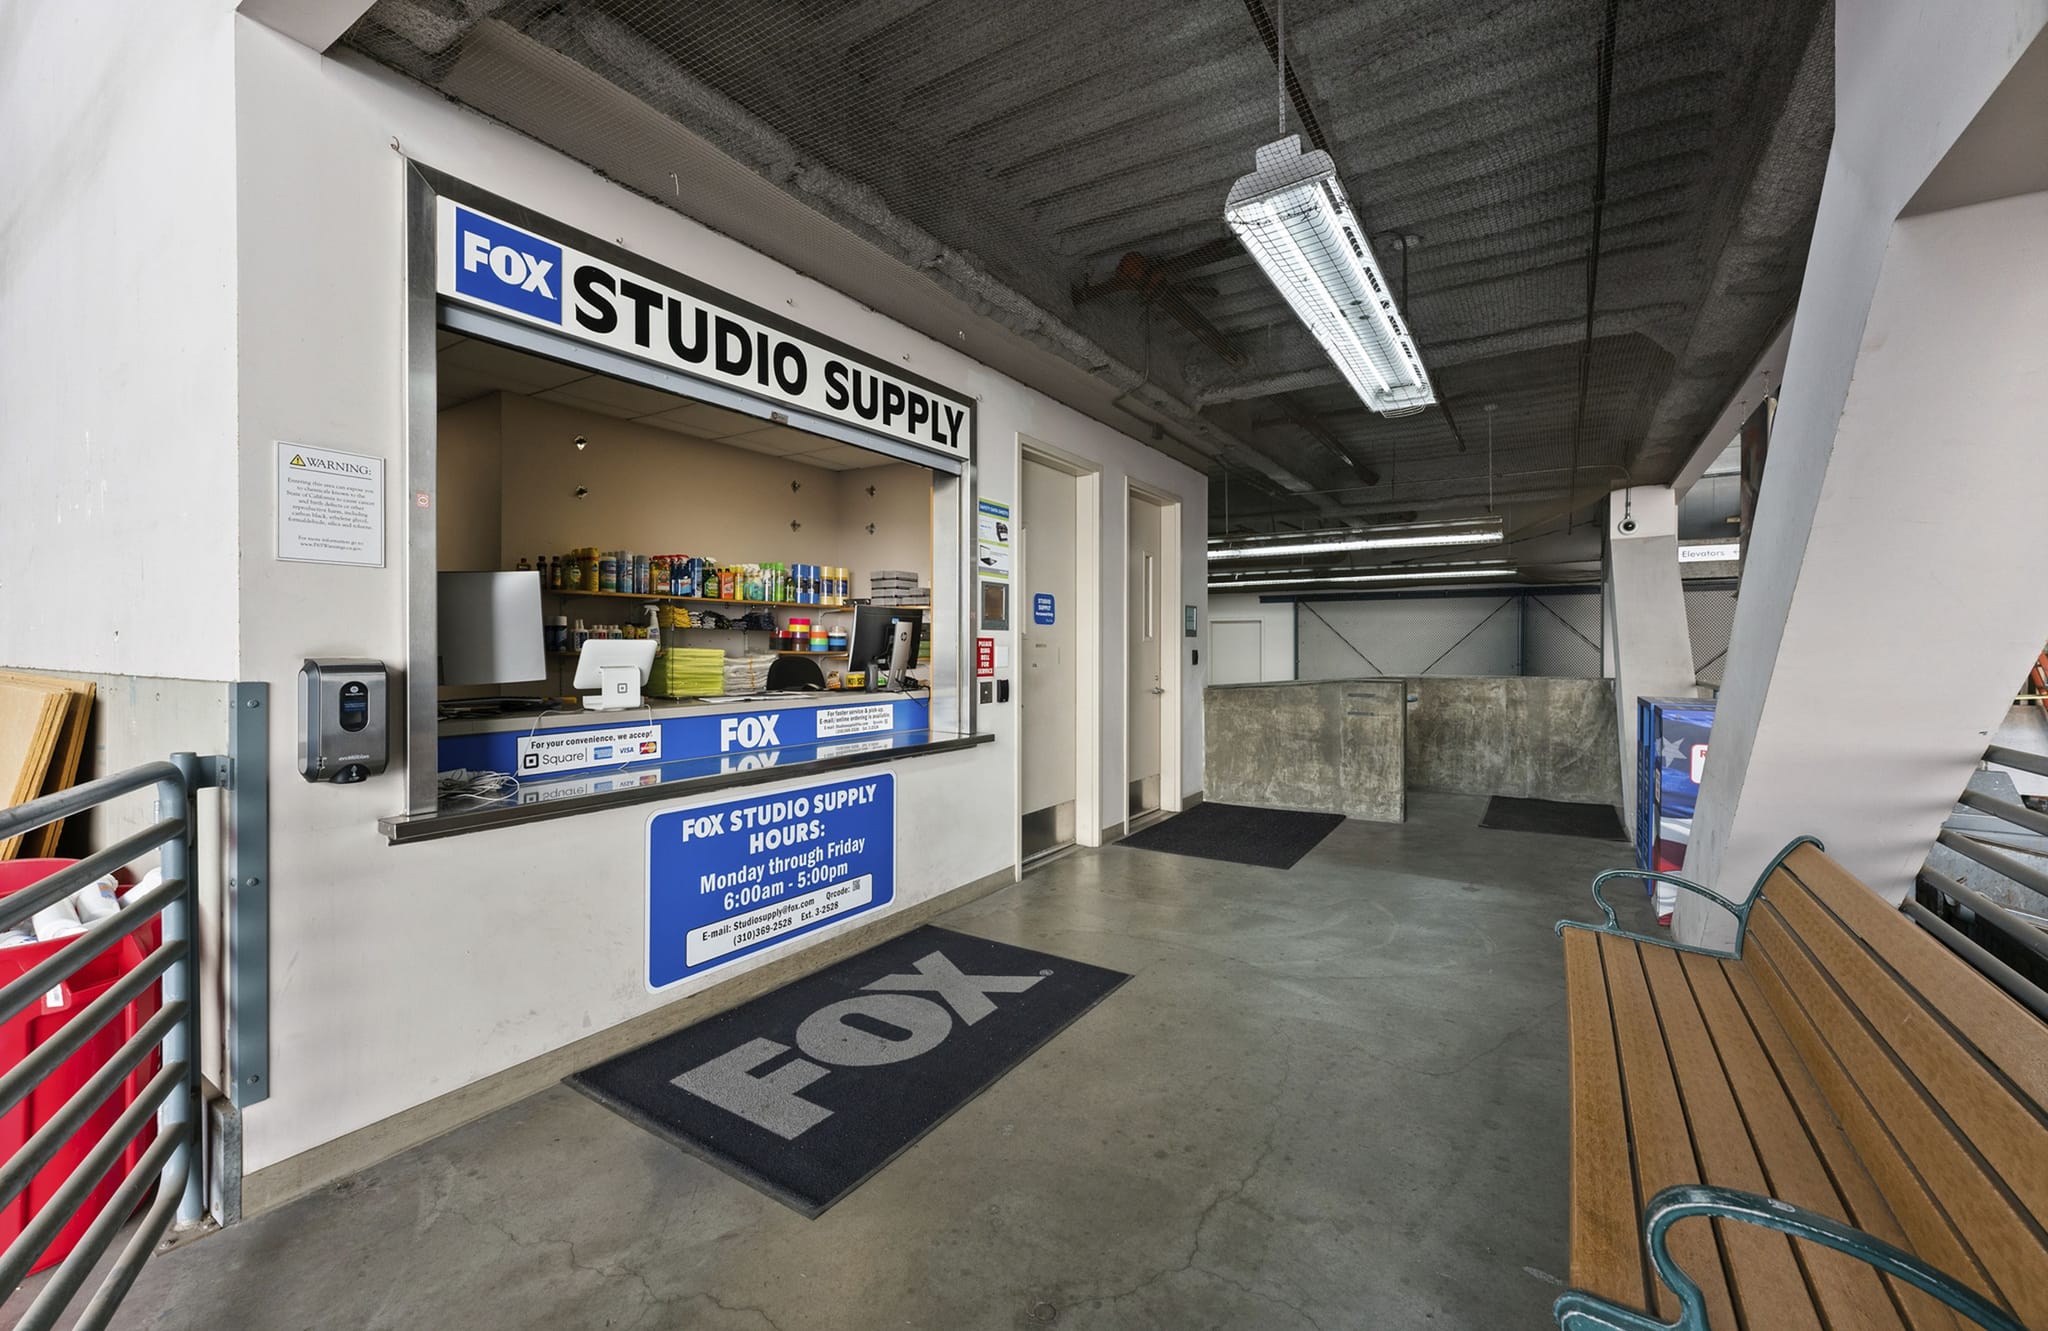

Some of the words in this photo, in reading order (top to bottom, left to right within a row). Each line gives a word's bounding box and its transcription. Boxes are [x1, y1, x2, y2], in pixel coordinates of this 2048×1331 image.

[464, 230, 554, 300] FOX
[573, 265, 807, 396] STUDIO
[824, 360, 965, 448] SUPPLY
[306, 457, 372, 475] WARNING:
[531, 741, 544, 750] For
[546, 738, 564, 748] your
[720, 714, 780, 753] FOX
[542, 752, 585, 766] Square
[682, 813, 725, 843] FOX
[730, 797, 810, 832] STUDIO
[814, 784, 876, 814] SUPPLY
[750, 819, 825, 854] HOURS:
[700, 864, 764, 894] Monday
[768, 846, 824, 875] through
[828, 838, 865, 859] Friday
[724, 880, 784, 912] 6:00am
[797, 862, 848, 888] 5:00pm
[702, 924, 732, 942] E-mail:
[734, 897, 814, 931] Studiosupply@fox.com
[733, 917, 793, 946] (310)369-2528
[801, 910, 814, 922] Ext.
[816, 900, 839, 916] 3-2528
[670, 950, 1048, 1141] FOX
